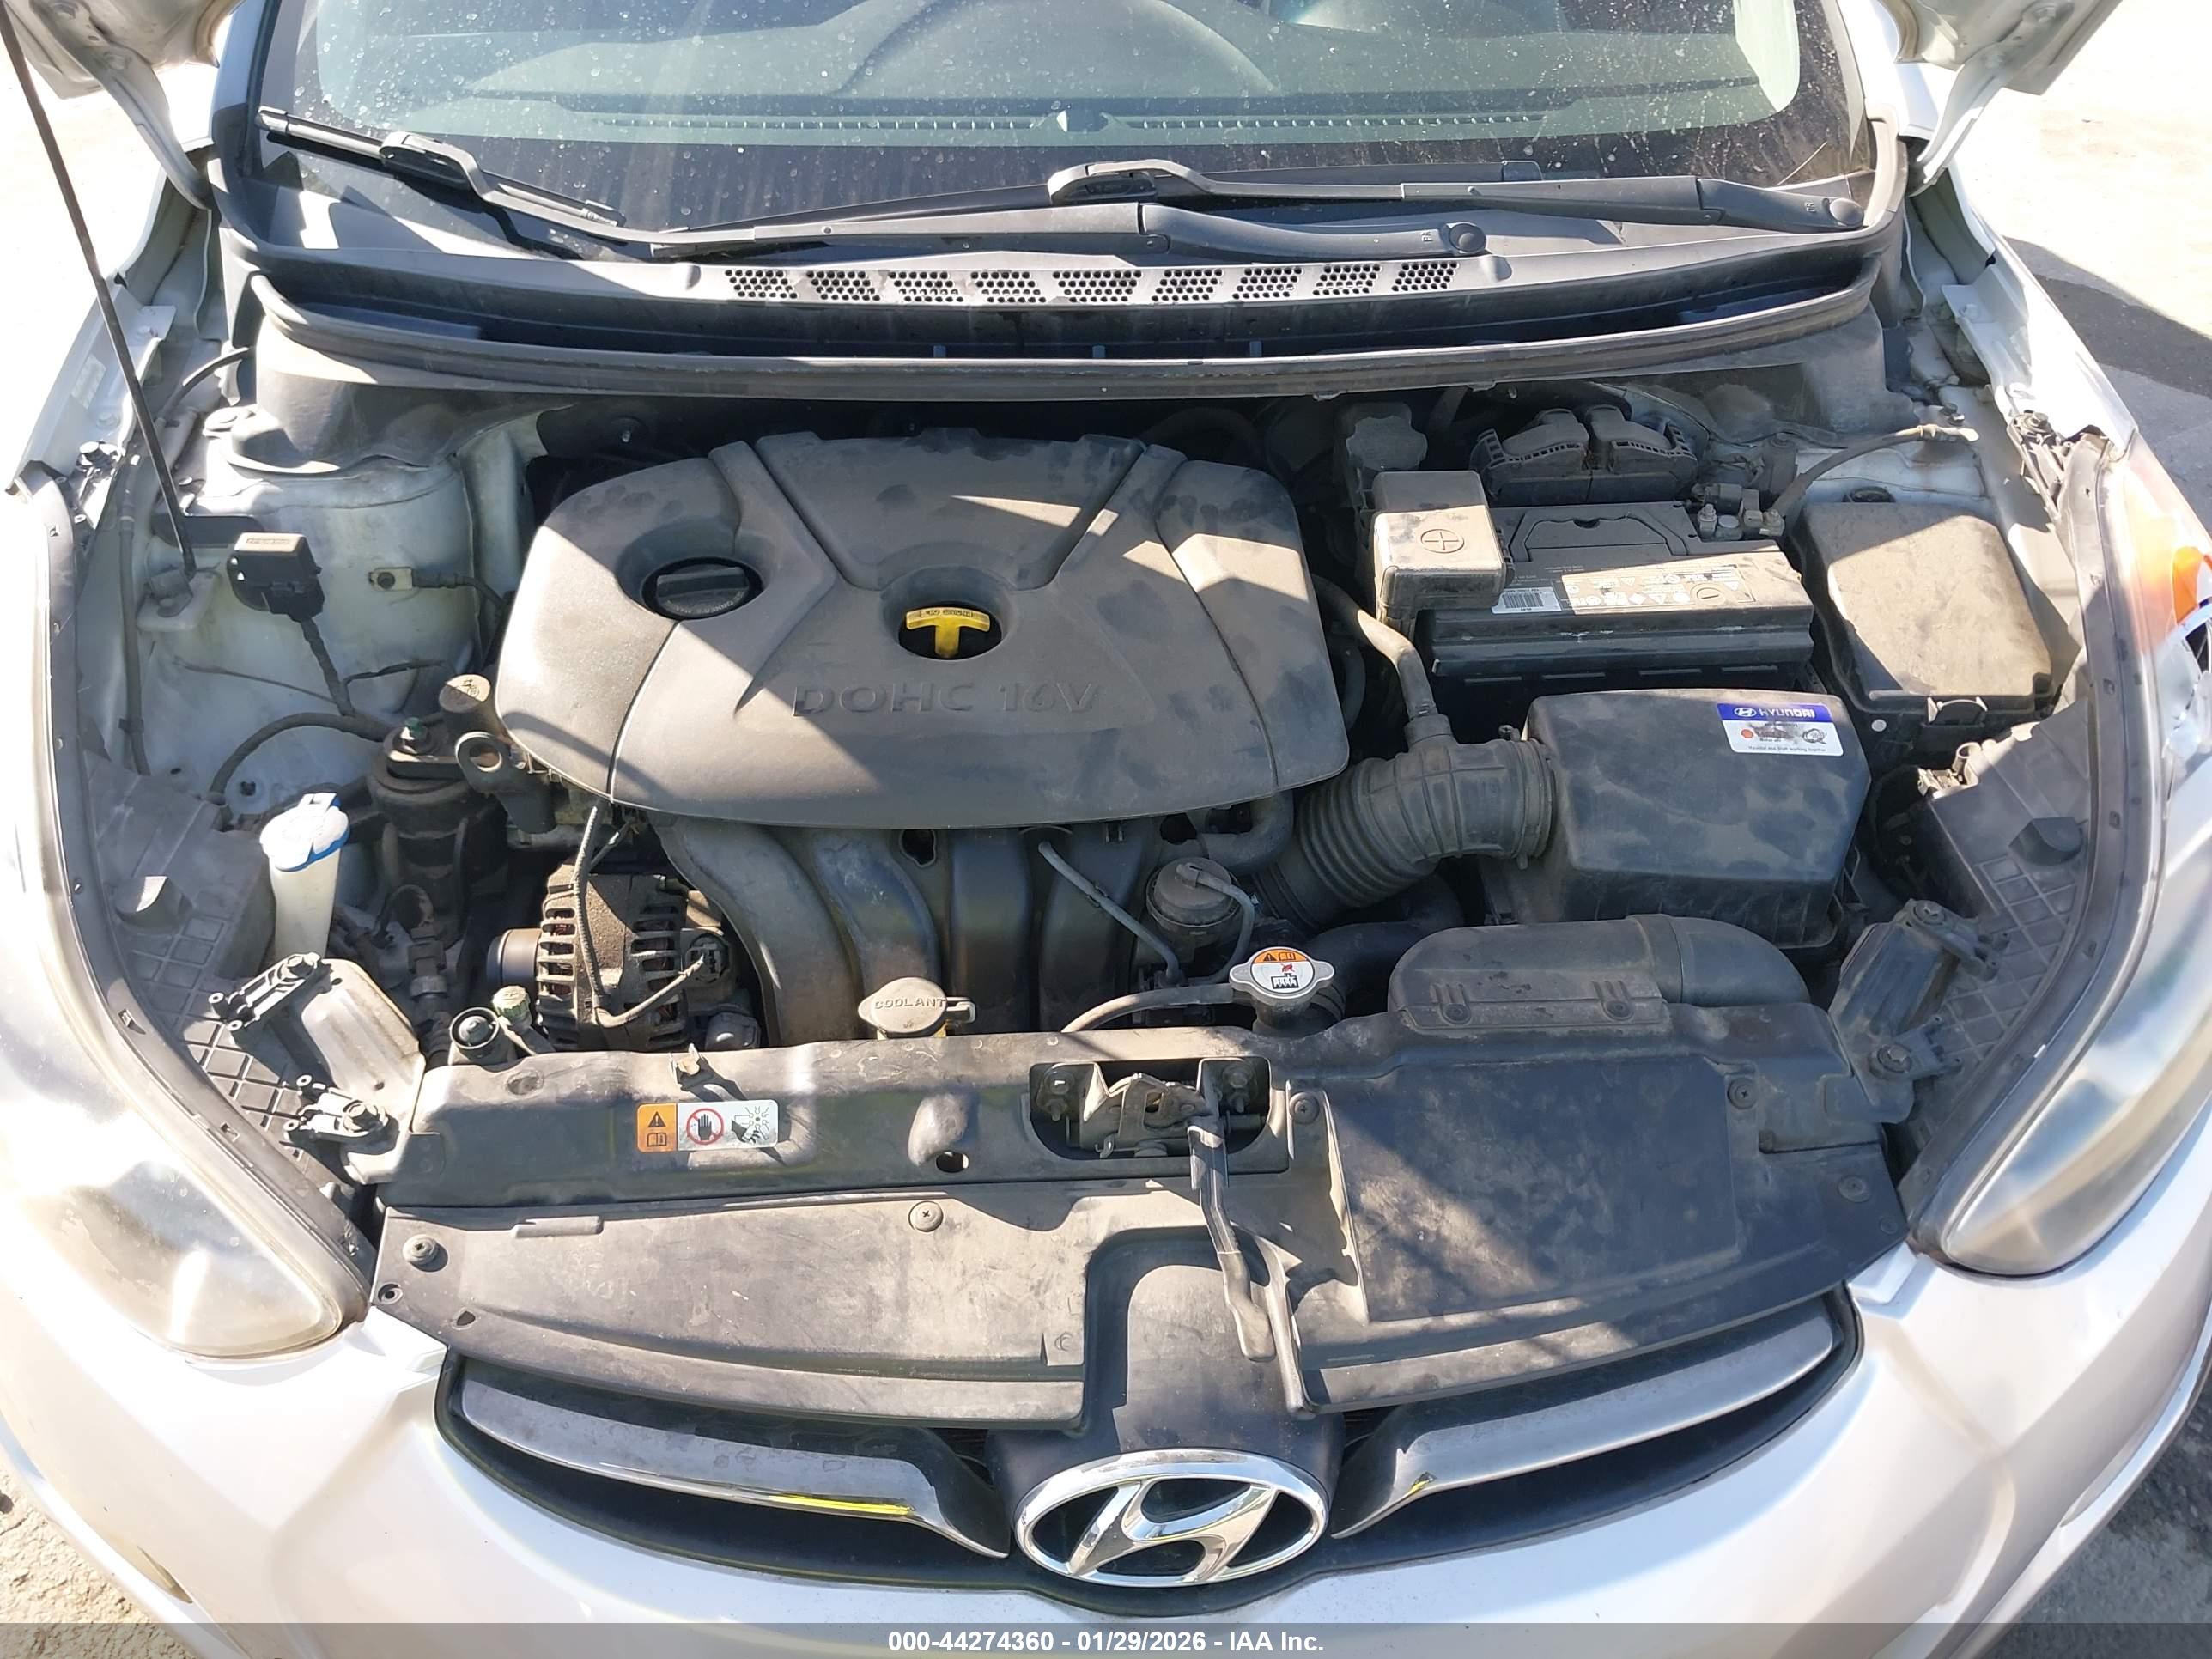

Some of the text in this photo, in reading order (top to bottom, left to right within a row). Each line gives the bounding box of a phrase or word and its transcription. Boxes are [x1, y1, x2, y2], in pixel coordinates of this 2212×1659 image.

[792, 682, 1099, 716] DOHC 16V
[1759, 708, 1815, 719] HYUNDAI
[874, 997, 947, 1010] COOLANT
